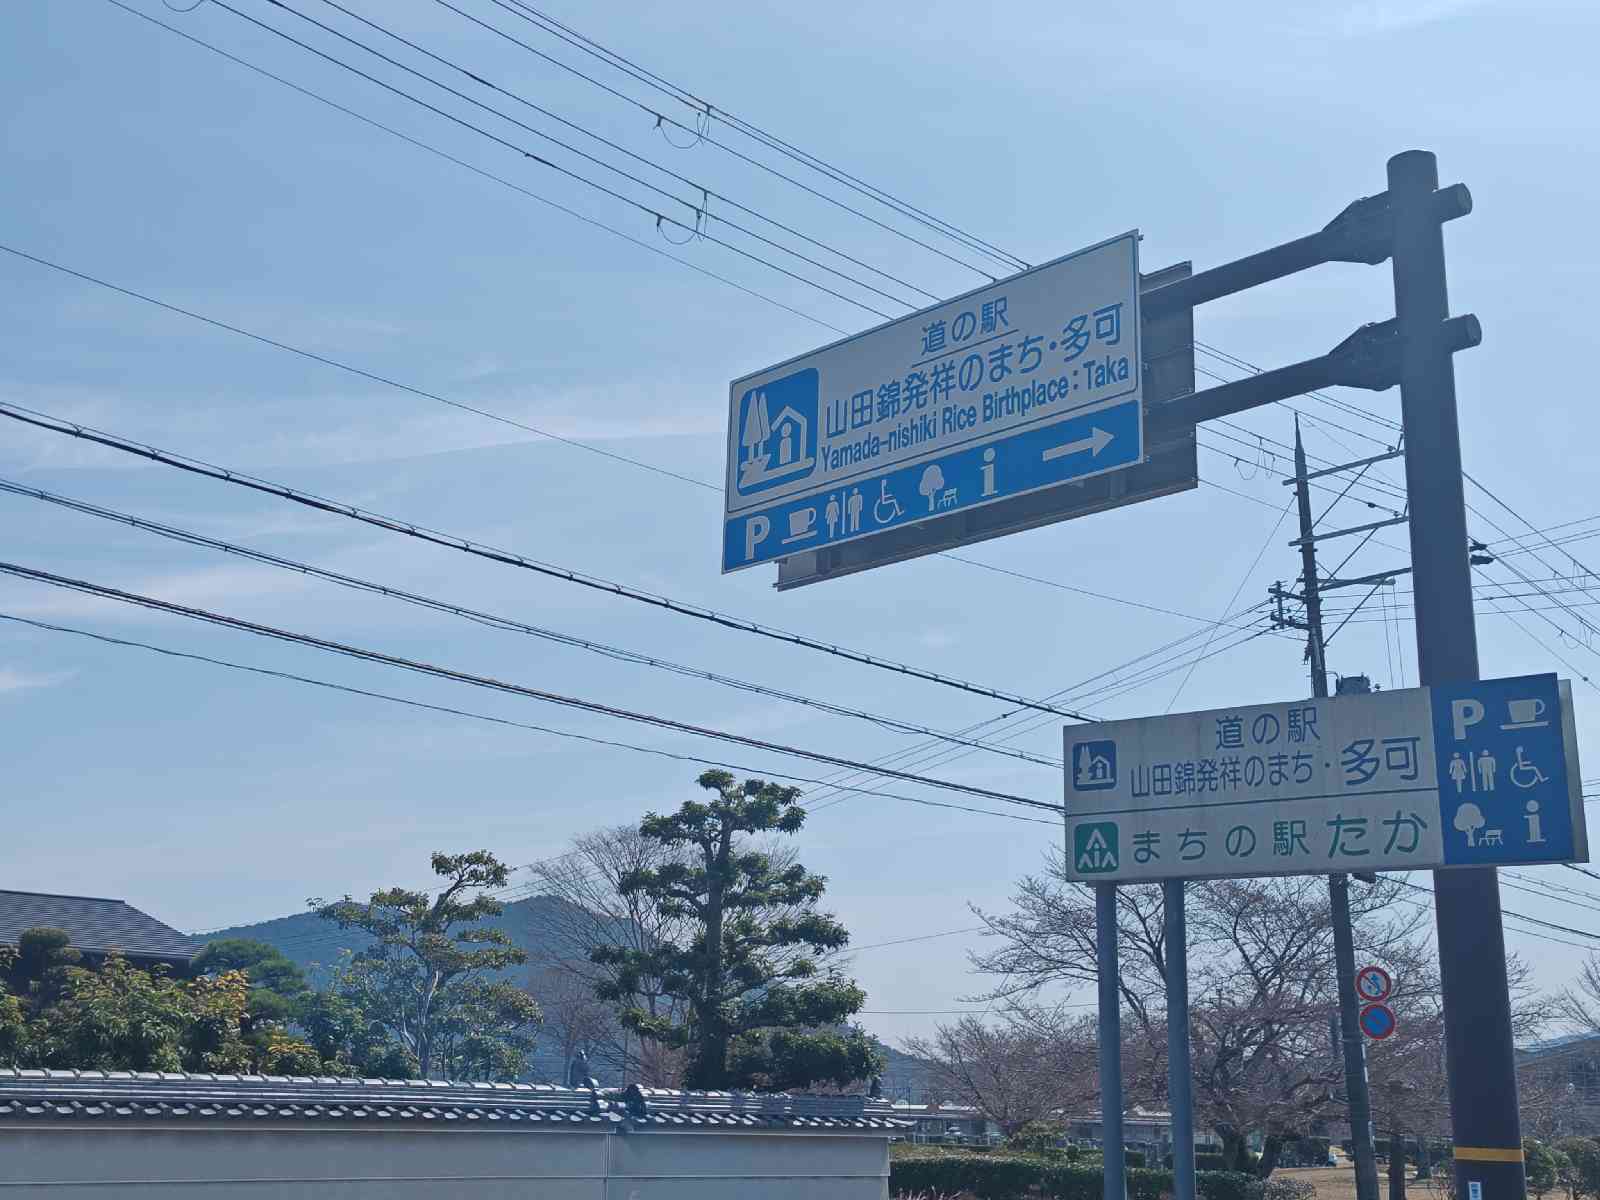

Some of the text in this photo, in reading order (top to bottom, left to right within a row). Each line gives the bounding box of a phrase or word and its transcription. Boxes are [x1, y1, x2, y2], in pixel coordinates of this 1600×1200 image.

[921, 296, 1009, 357] 道の駅
[822, 414, 937, 473] Yamada-nishiki
[943, 399, 977, 432] Rice
[1083, 355, 1130, 388] Taka
[1215, 707, 1320, 751] 道の駅
